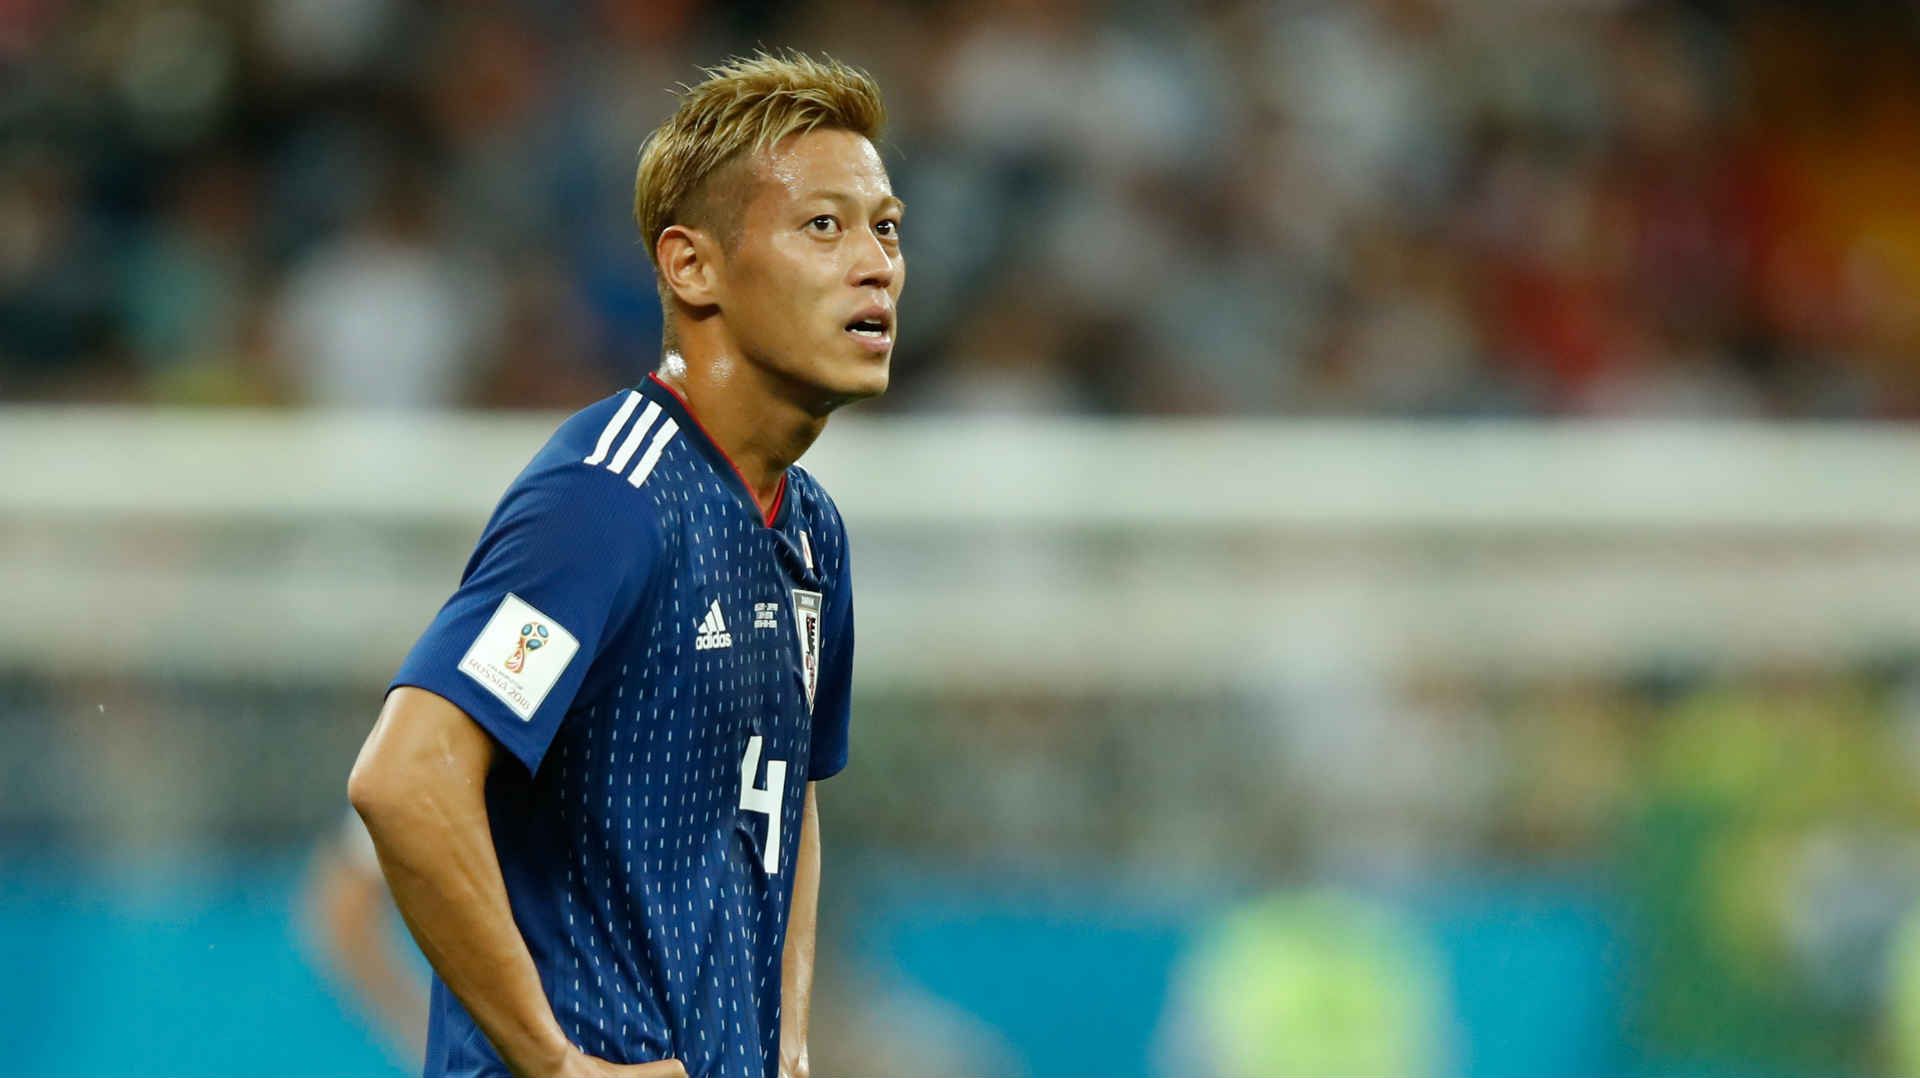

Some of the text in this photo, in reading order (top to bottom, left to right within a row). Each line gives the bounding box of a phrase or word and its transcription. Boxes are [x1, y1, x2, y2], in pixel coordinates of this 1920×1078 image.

[695, 632, 732, 650] adidas
[468, 659, 508, 691] RUSSIA
[739, 735, 787, 874] 4
